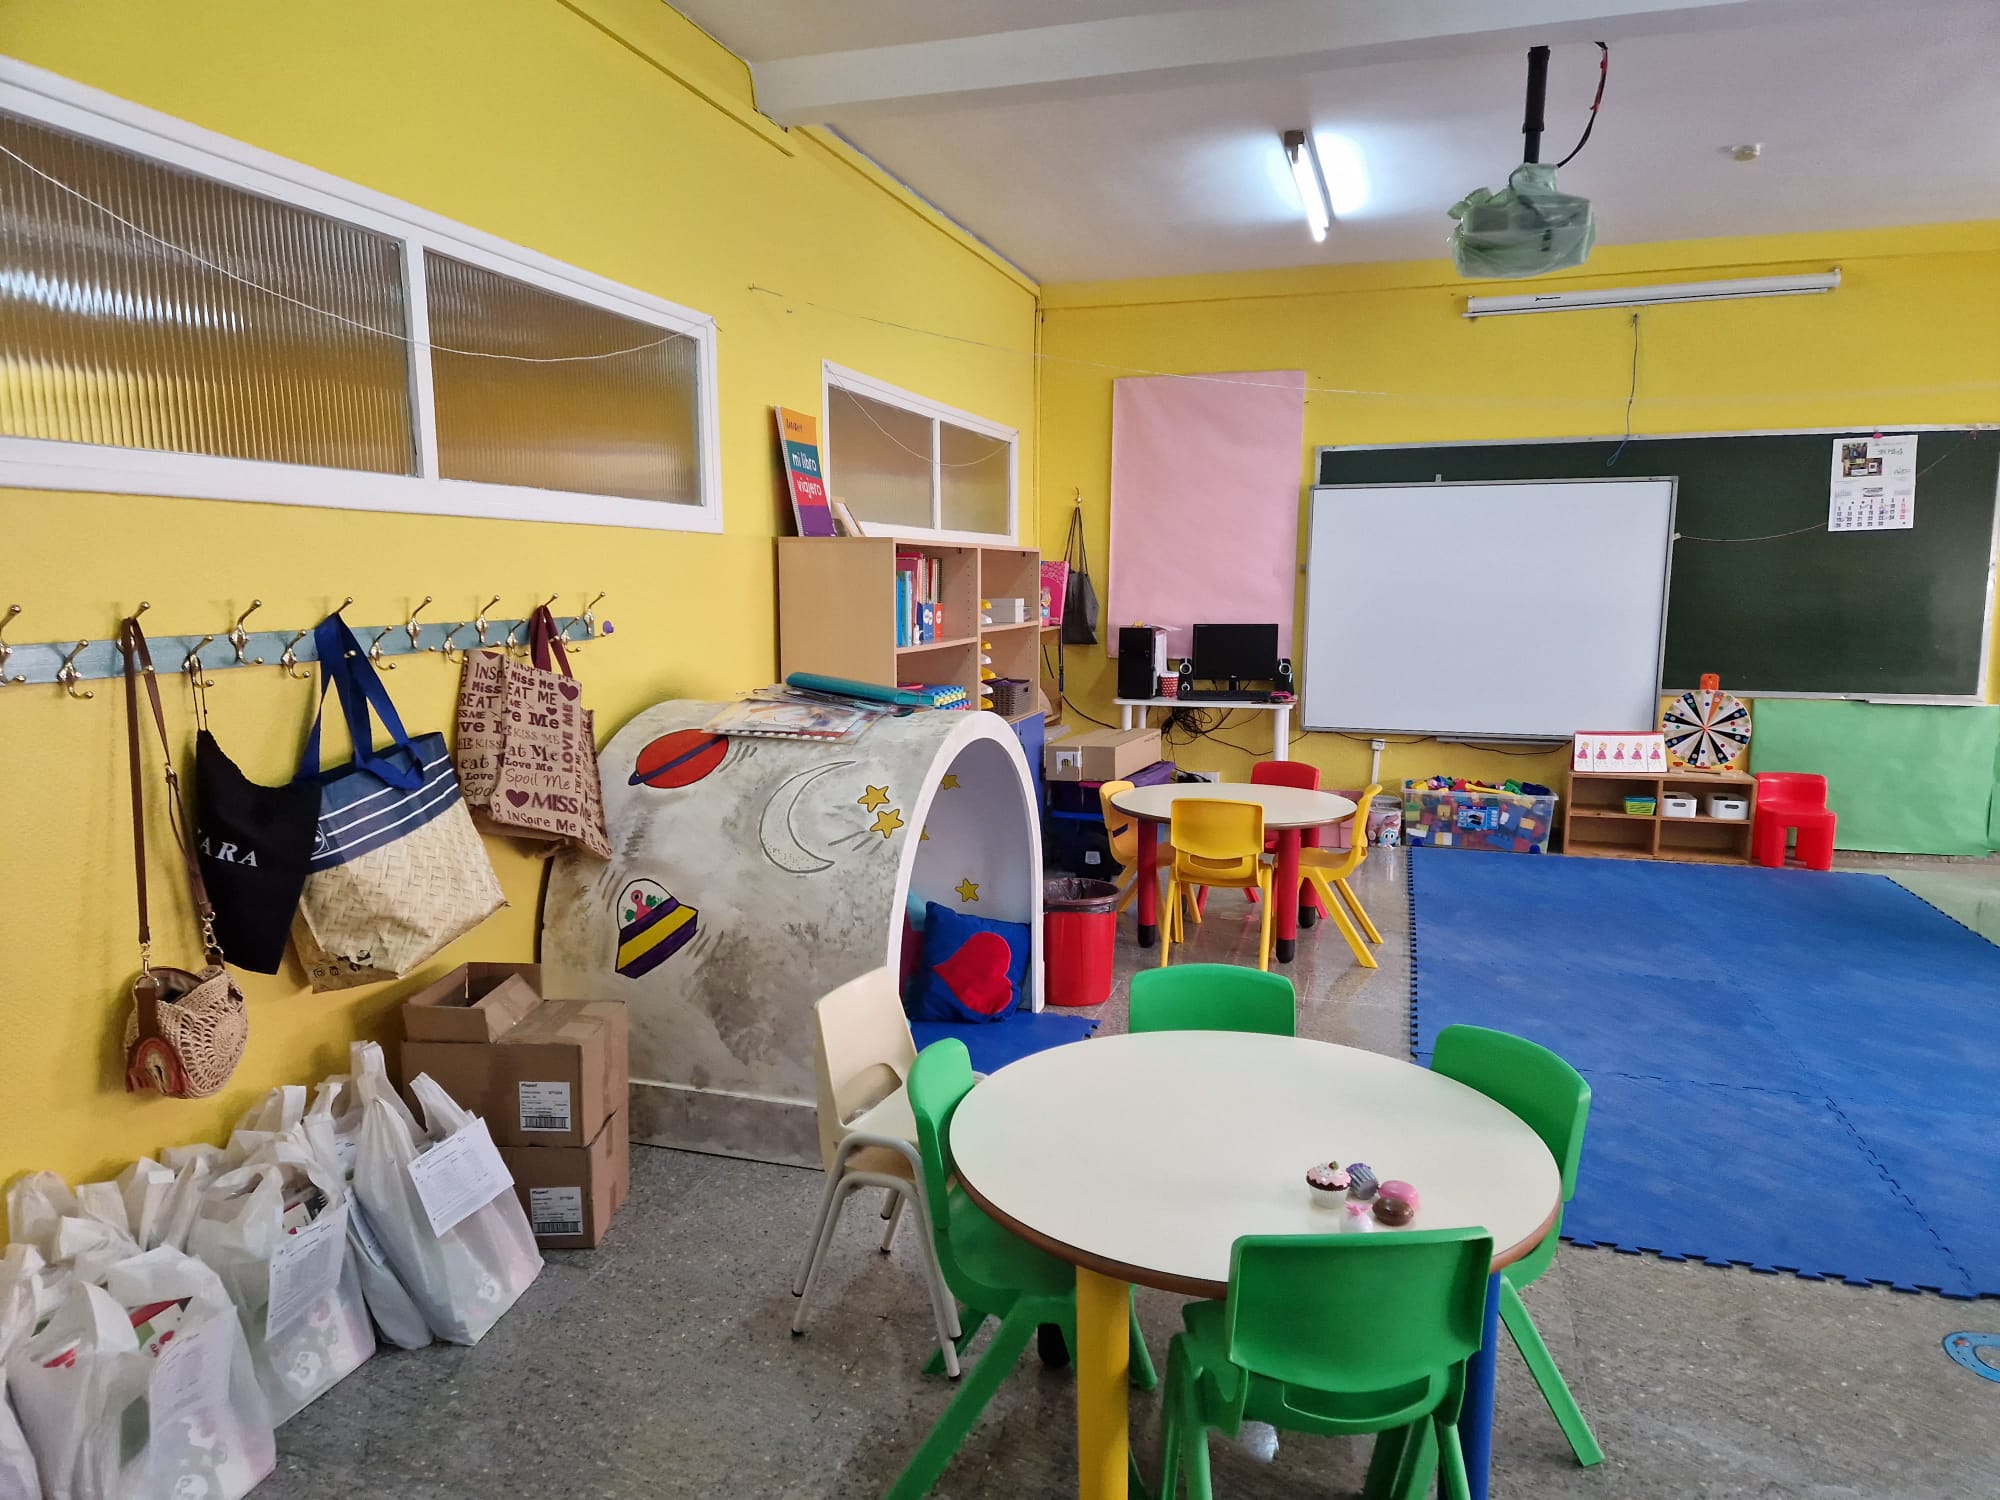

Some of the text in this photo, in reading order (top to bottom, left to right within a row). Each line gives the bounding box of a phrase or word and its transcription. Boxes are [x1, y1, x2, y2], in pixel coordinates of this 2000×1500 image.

[801, 451, 817, 472] libro
[797, 477, 822, 499] viajero
[511, 670, 535, 687] Miss
[538, 690, 558, 706] ME
[528, 711, 560, 729] Me
[562, 702, 574, 773] LOVE ME
[529, 744, 559, 762] Me
[505, 757, 553, 772] Love Me
[504, 767, 570, 790] Spoil Me
[531, 791, 579, 815] MISS
[556, 818, 577, 833] Me
[198, 829, 258, 868] ARA
